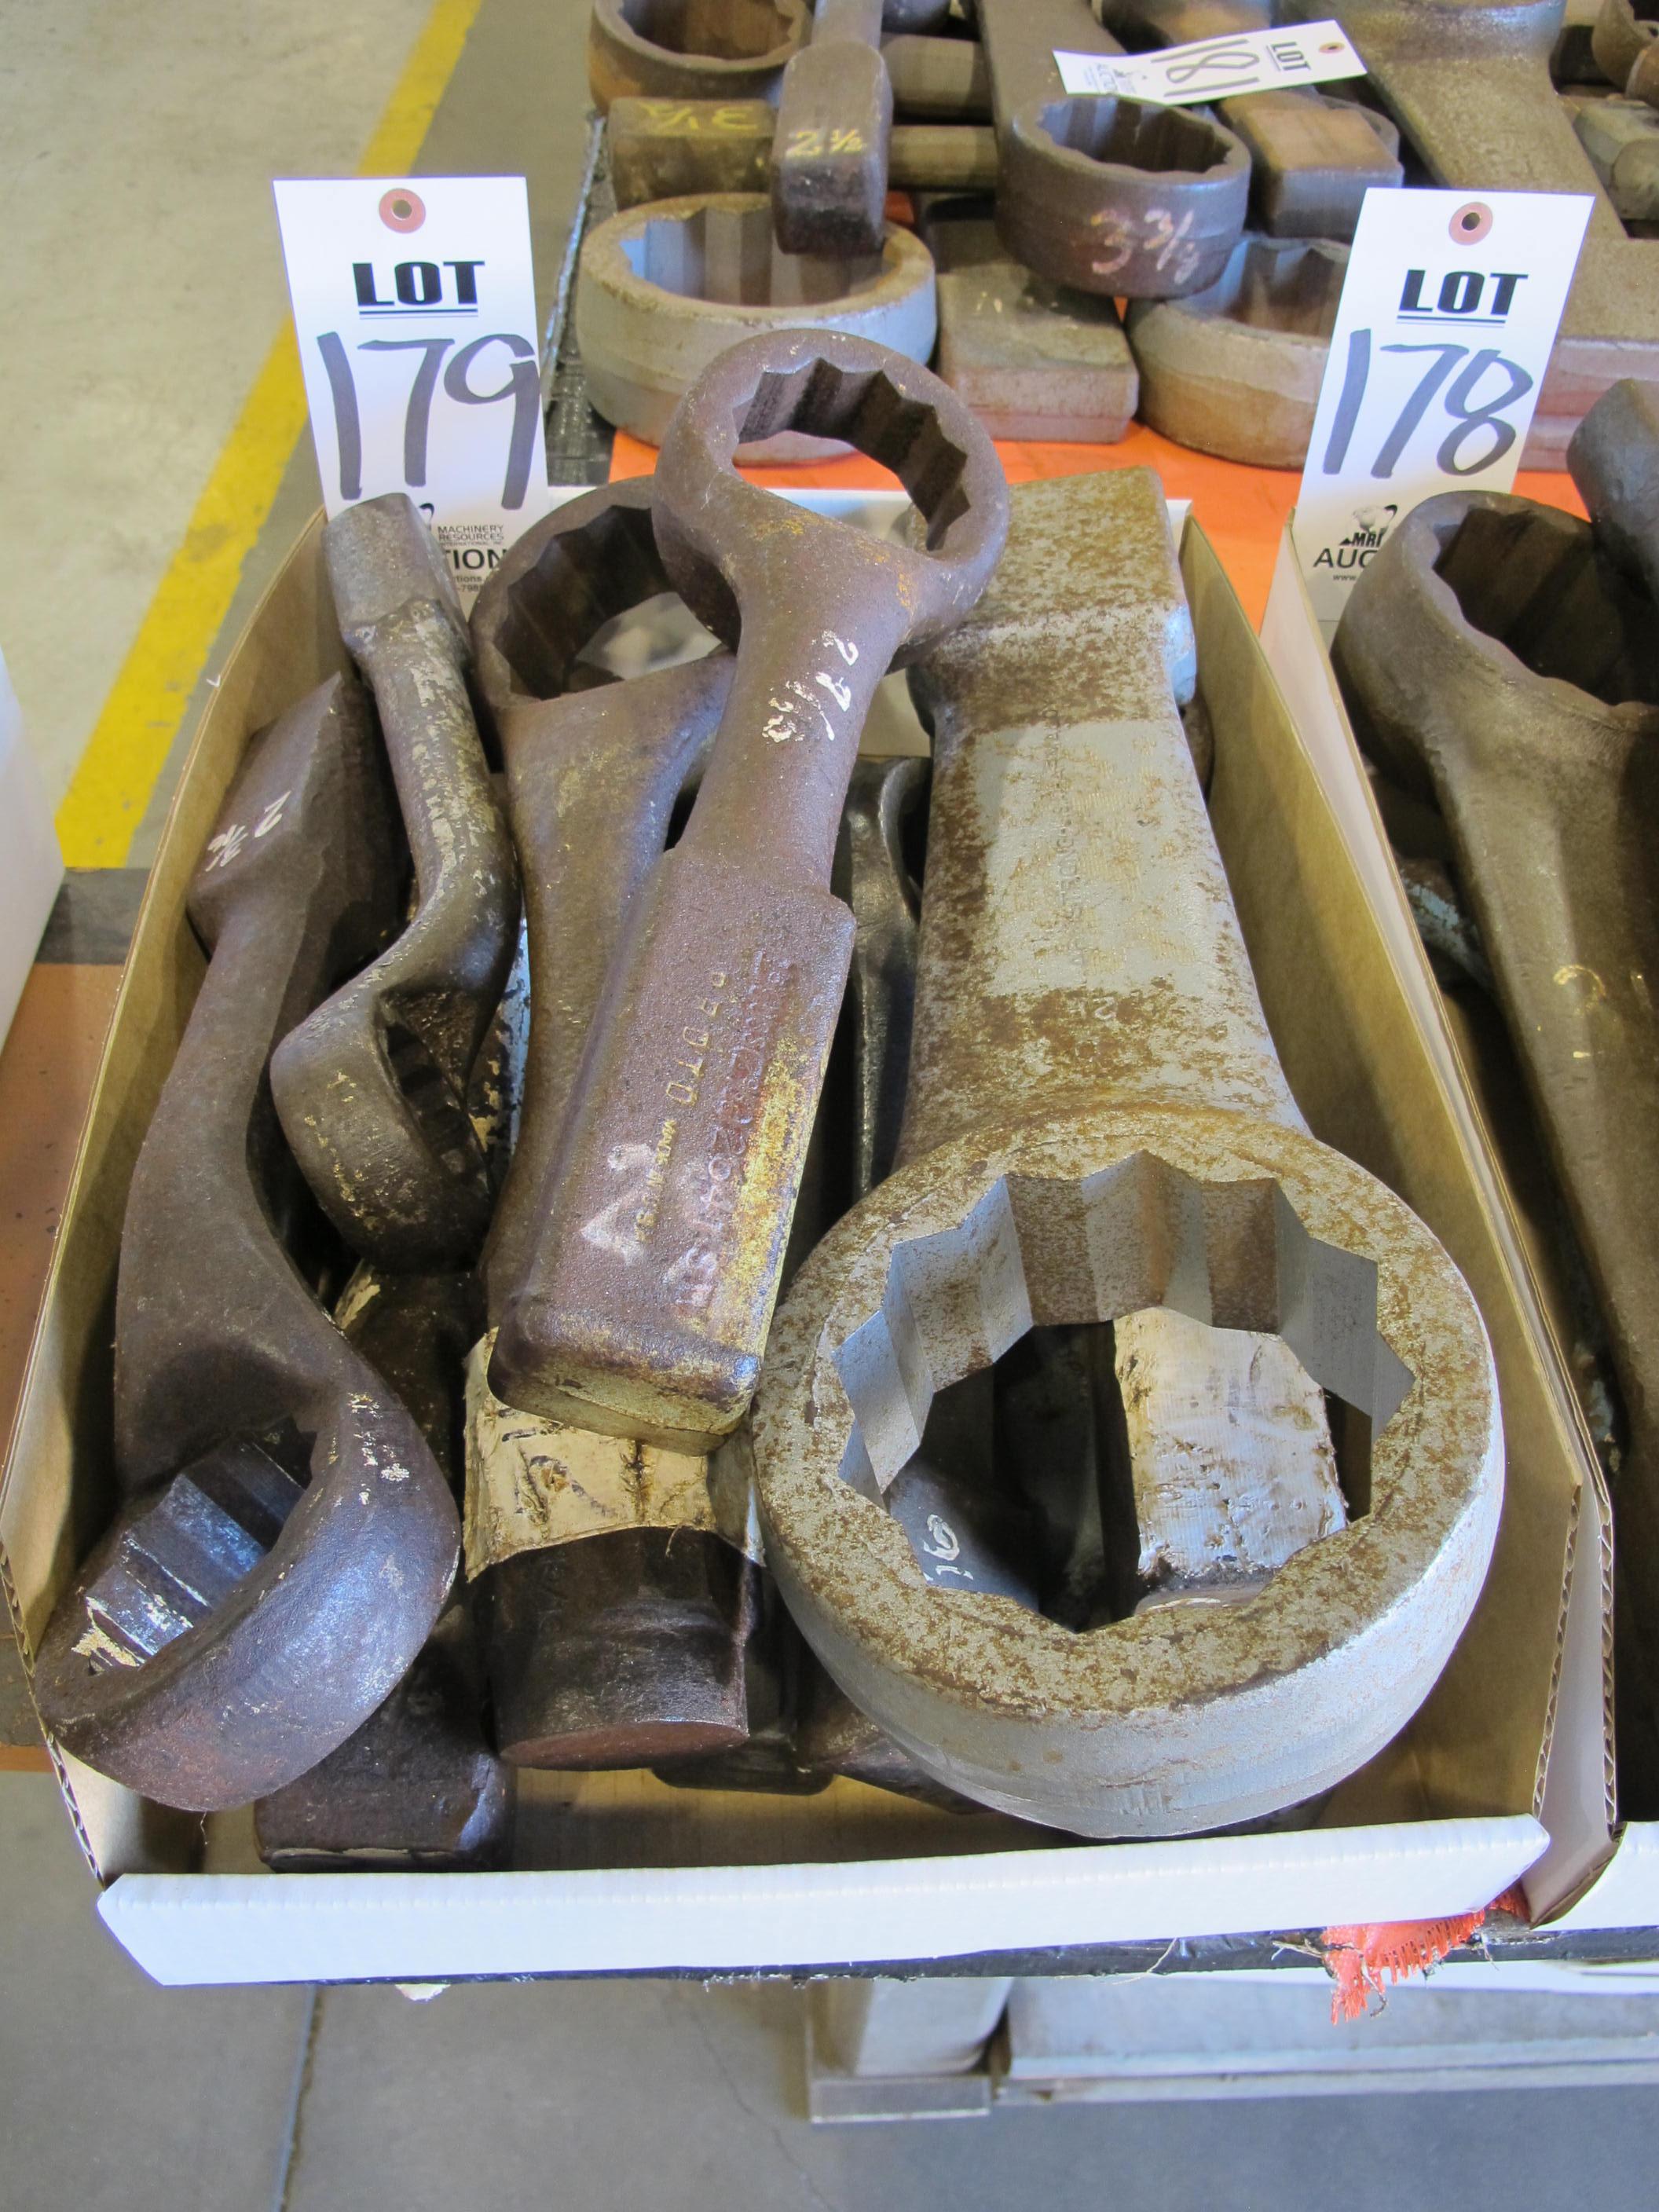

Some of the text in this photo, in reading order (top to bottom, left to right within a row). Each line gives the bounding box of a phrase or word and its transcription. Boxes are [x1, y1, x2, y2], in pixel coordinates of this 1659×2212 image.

[1150, 38, 1261, 99] 181
[1272, 42, 1312, 71] LOT
[787, 129, 822, 157] 2
[1090, 207, 1133, 275] 3
[352, 260, 485, 307] LOT
[1398, 269, 1529, 317] LOT
[316, 331, 540, 511] 179
[1322, 328, 1533, 480] 178
[438, 525, 504, 534] MACHINERY
[438, 533, 504, 542] RESOURCES
